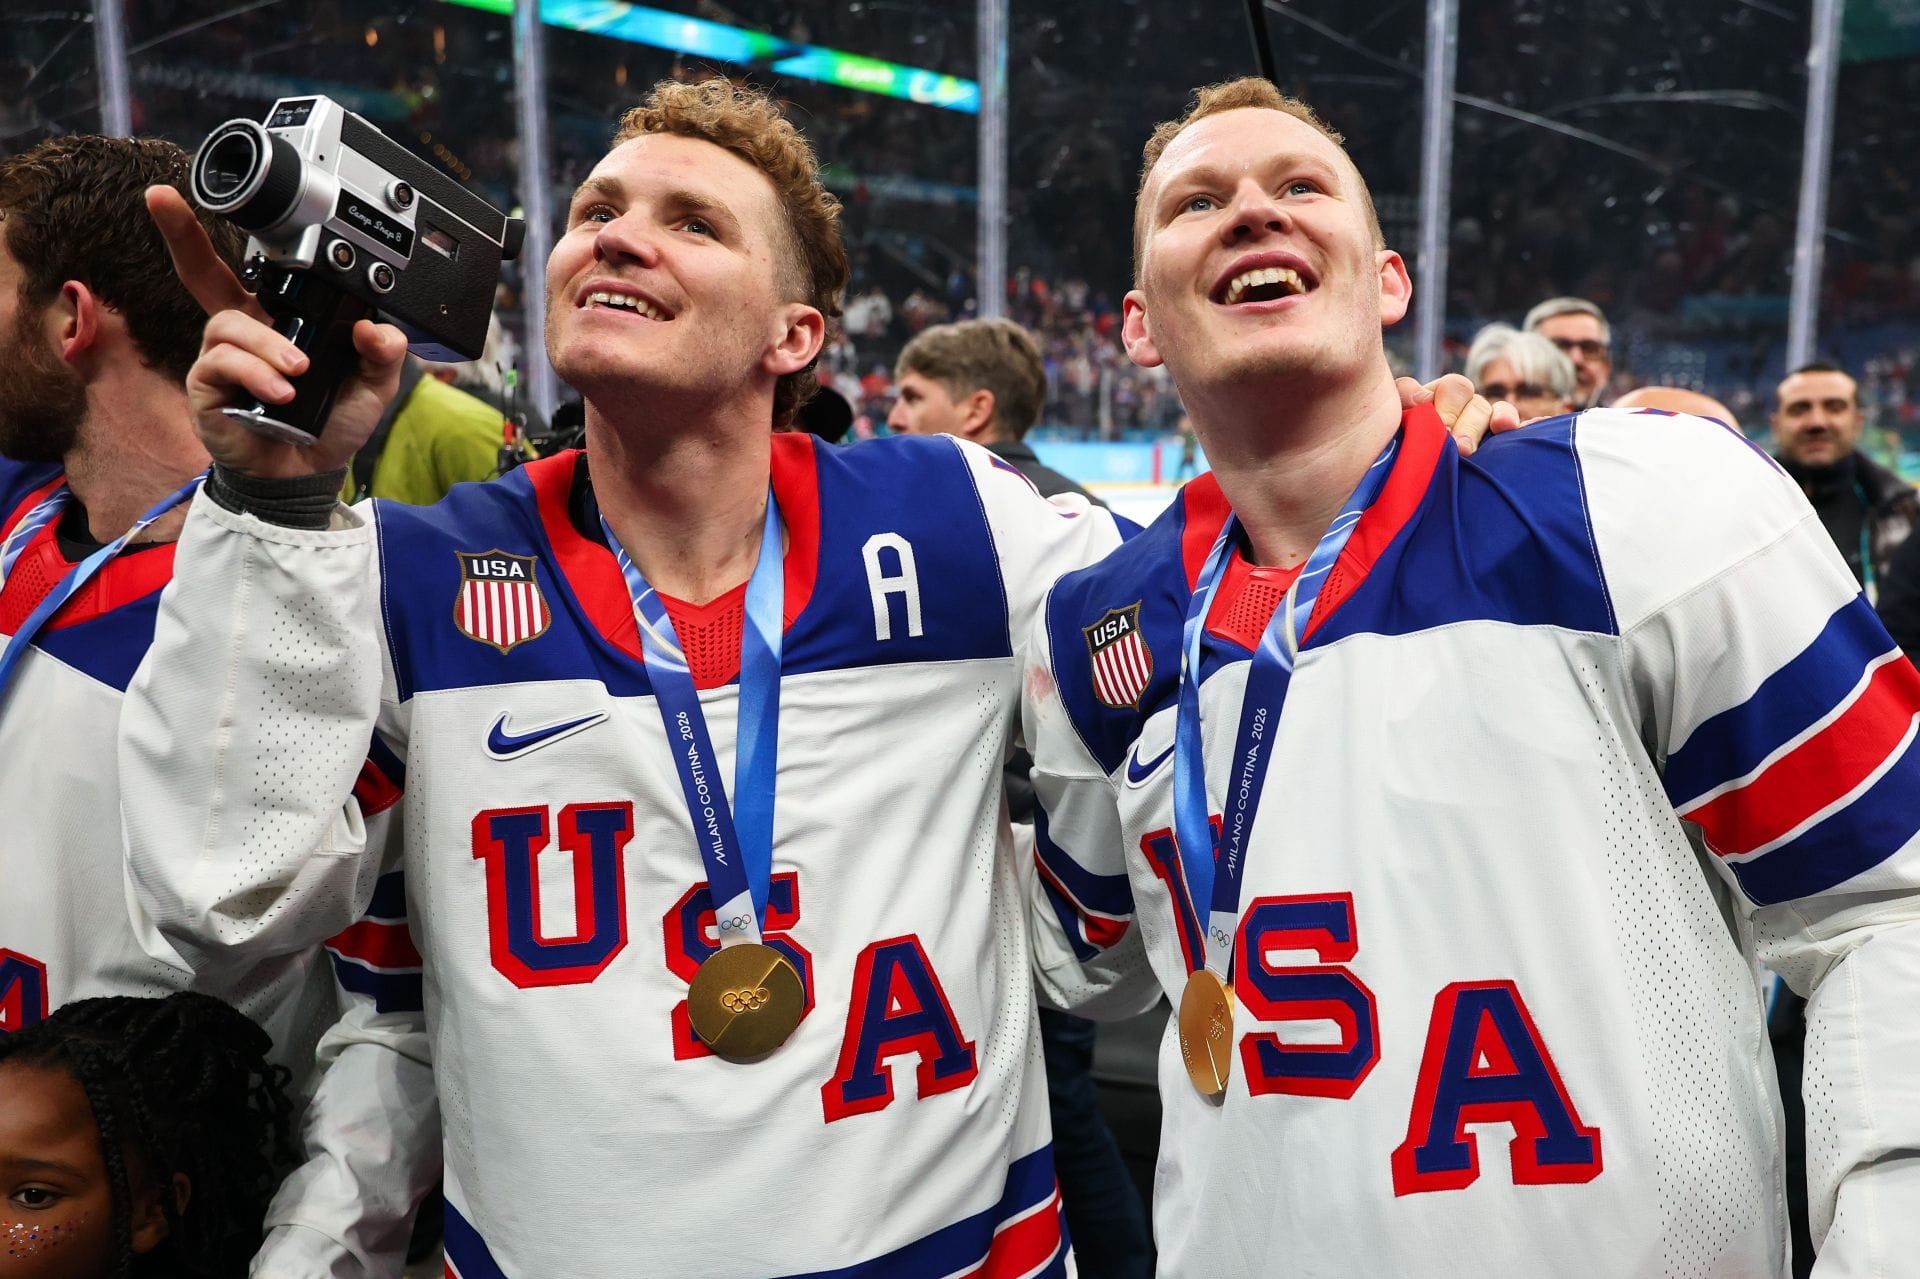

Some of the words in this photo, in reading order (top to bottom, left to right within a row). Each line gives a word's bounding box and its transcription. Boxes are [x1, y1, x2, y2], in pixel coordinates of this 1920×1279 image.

[348, 205, 372, 226] Camp
[373, 220, 395, 240] Snap
[395, 232, 402, 242] 8
[472, 558, 526, 578] USA
[862, 532, 923, 641] A
[1093, 614, 1130, 647] USA
[675, 711, 694, 741] 2026
[687, 743, 711, 806] CORTINA
[1227, 812, 1244, 879] MILANO
[1237, 744, 1260, 810] CORTINA
[1251, 707, 1267, 741] 2026
[703, 806, 728, 866] MILANO
